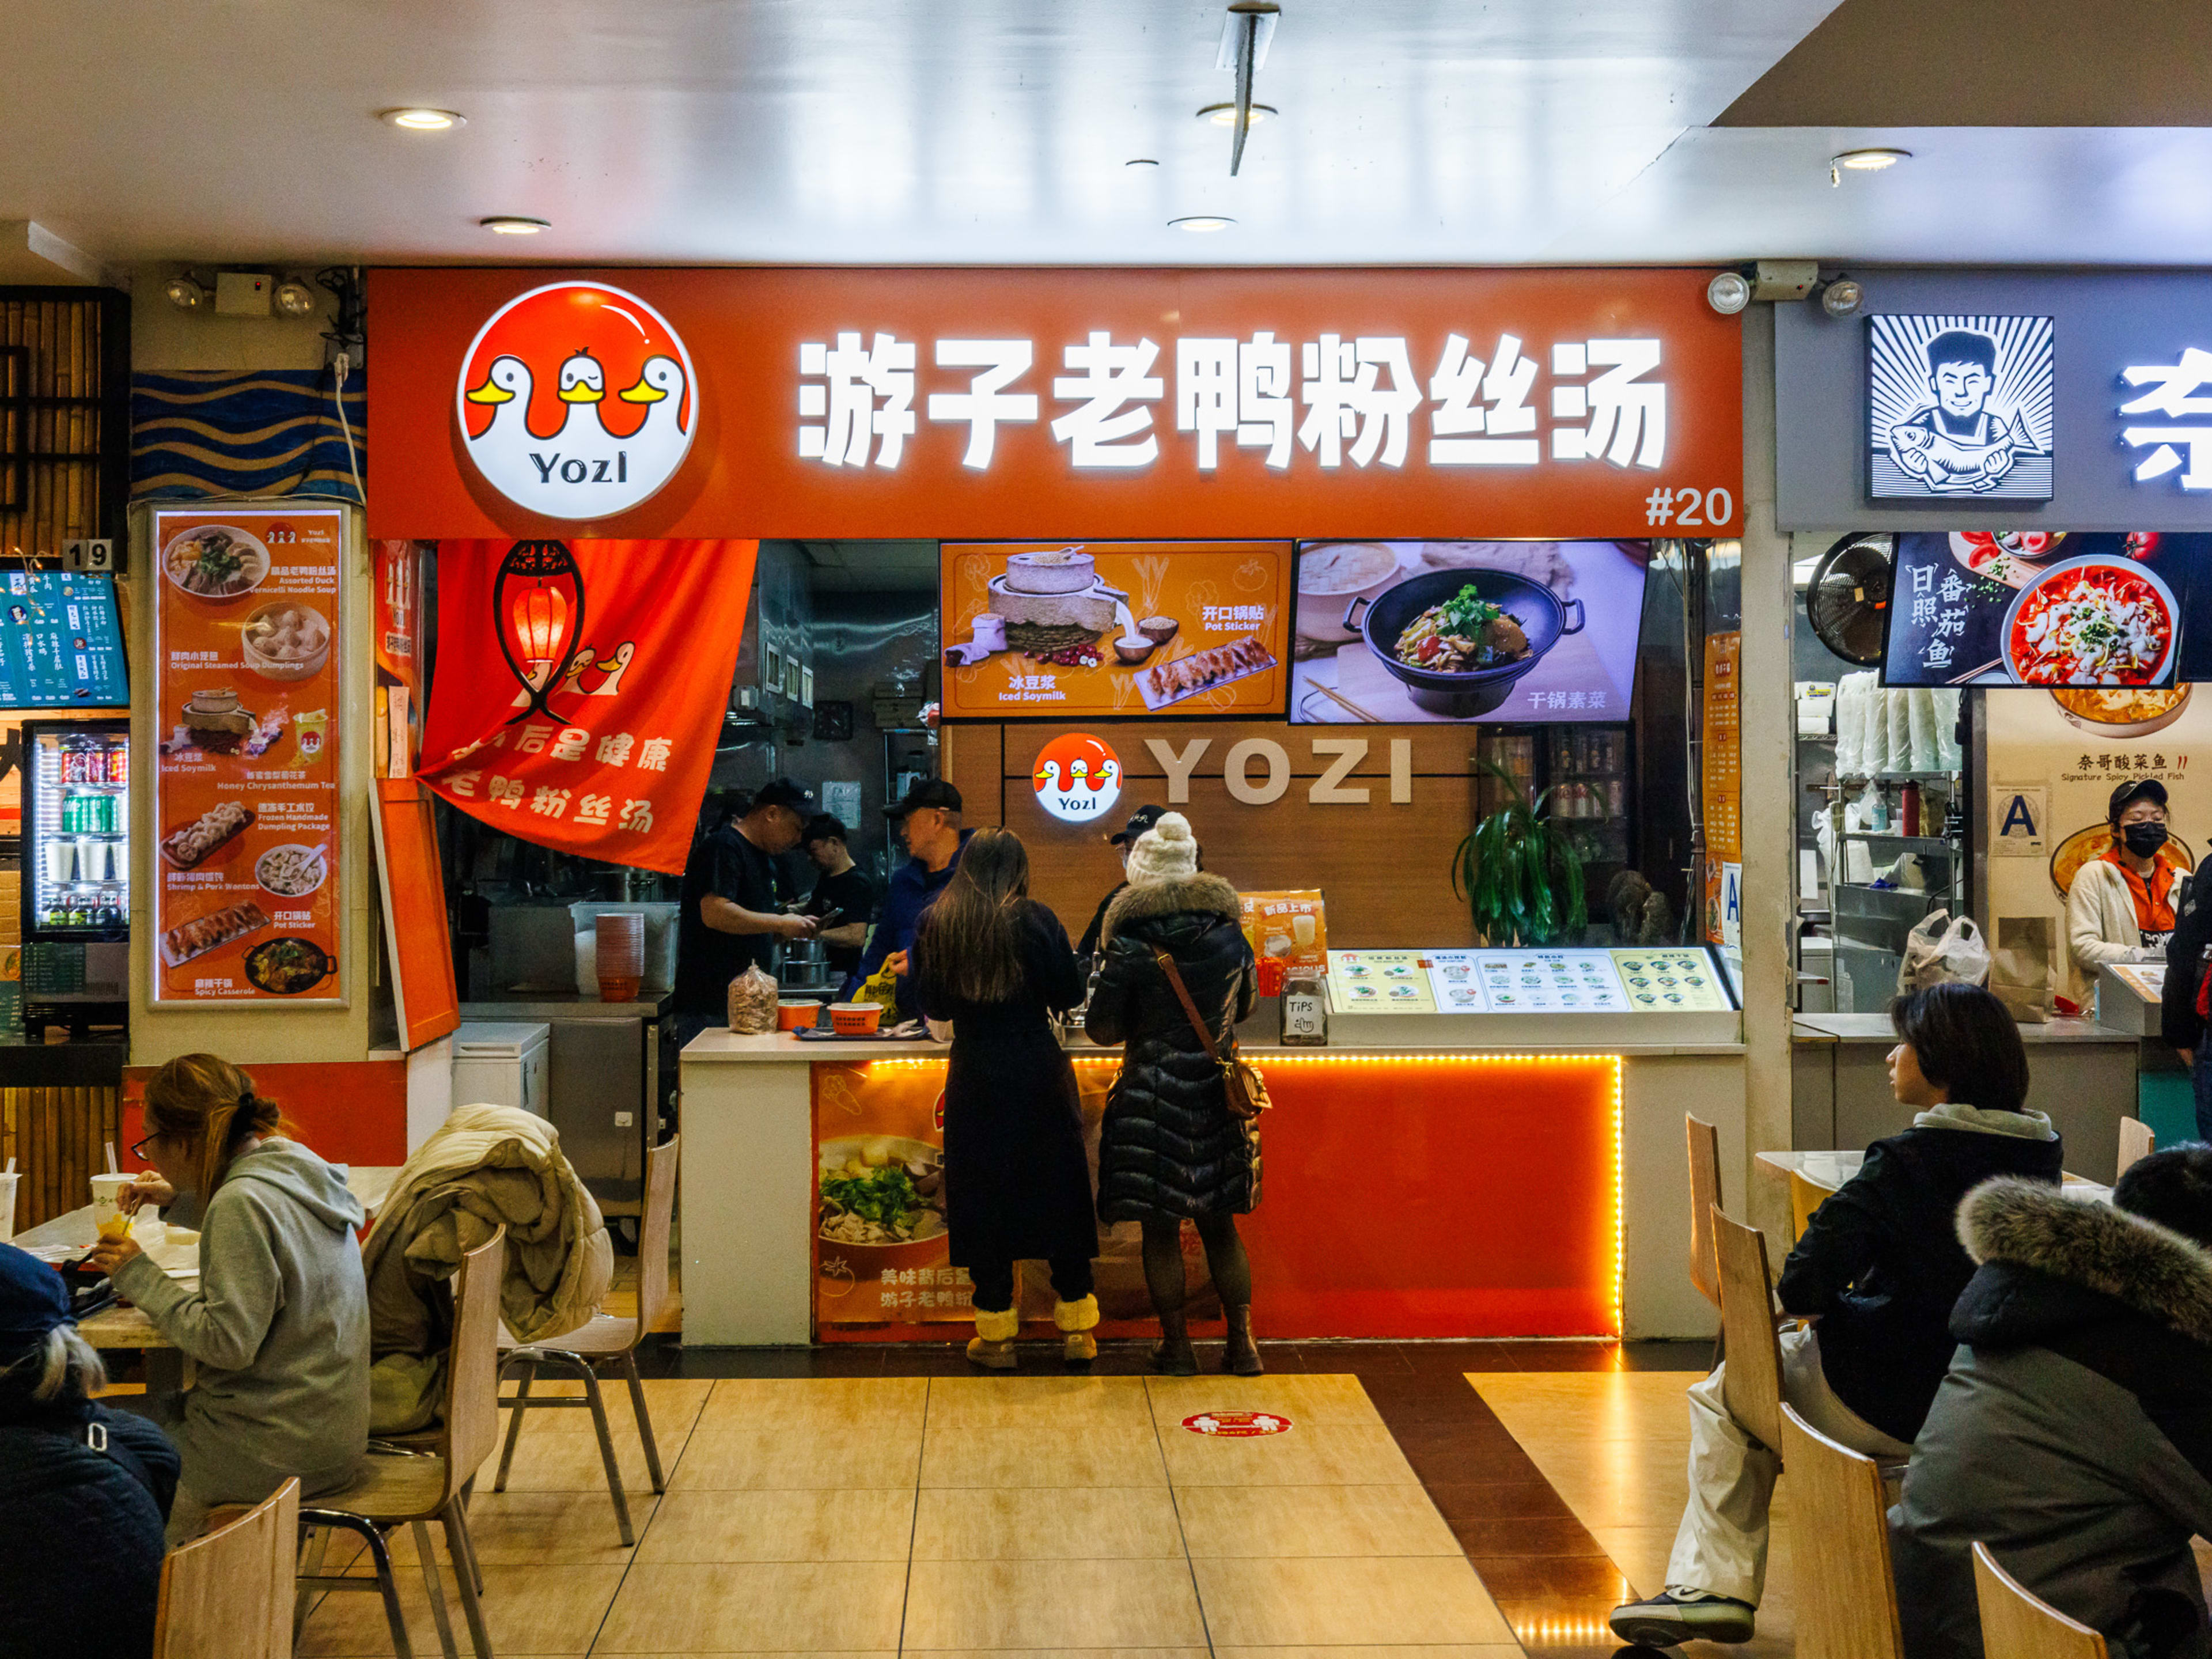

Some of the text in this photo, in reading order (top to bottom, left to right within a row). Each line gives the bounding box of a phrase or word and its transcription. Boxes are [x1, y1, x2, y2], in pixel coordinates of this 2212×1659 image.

[798, 332, 1667, 470] 游子老鸭粉丝汤
[1646, 487, 1732, 526] #20
[68, 543, 107, 566] 19
[317, 586, 336, 594] Soup
[1911, 565, 1938, 625] 日照
[1202, 605, 1264, 620] 开口锅贴
[1205, 622, 1260, 631] Pot Sticker
[171, 652, 218, 661] 鲜肉小笼包
[171, 662, 202, 670] Original
[240, 662, 260, 671] Soup
[262, 662, 304, 671] Dumplings
[1009, 675, 1056, 690] 冰豆浆
[999, 691, 1066, 702] Iced Soymilk
[1527, 691, 1607, 710] 干锅素菜
[494, 724, 673, 772] 后是健康
[175, 753, 203, 762] 冰豆浆
[2078, 753, 2167, 771] 奈哥酸菜鱼
[181, 765, 216, 773] Soymilk
[1143, 738, 1411, 805] YOZI
[2061, 773, 2101, 782] Signature
[2106, 773, 2128, 782] Spicy
[217, 782, 245, 791] Honey
[247, 782, 319, 790] Chrysanthemum
[2000, 795, 2037, 836] A
[258, 823, 330, 831] Dumpling Package
[167, 883, 195, 892] Shrimp
[1727, 873, 1739, 922] A
[274, 911, 311, 921] 开口锅贴
[195, 988, 215, 997] Spicy
